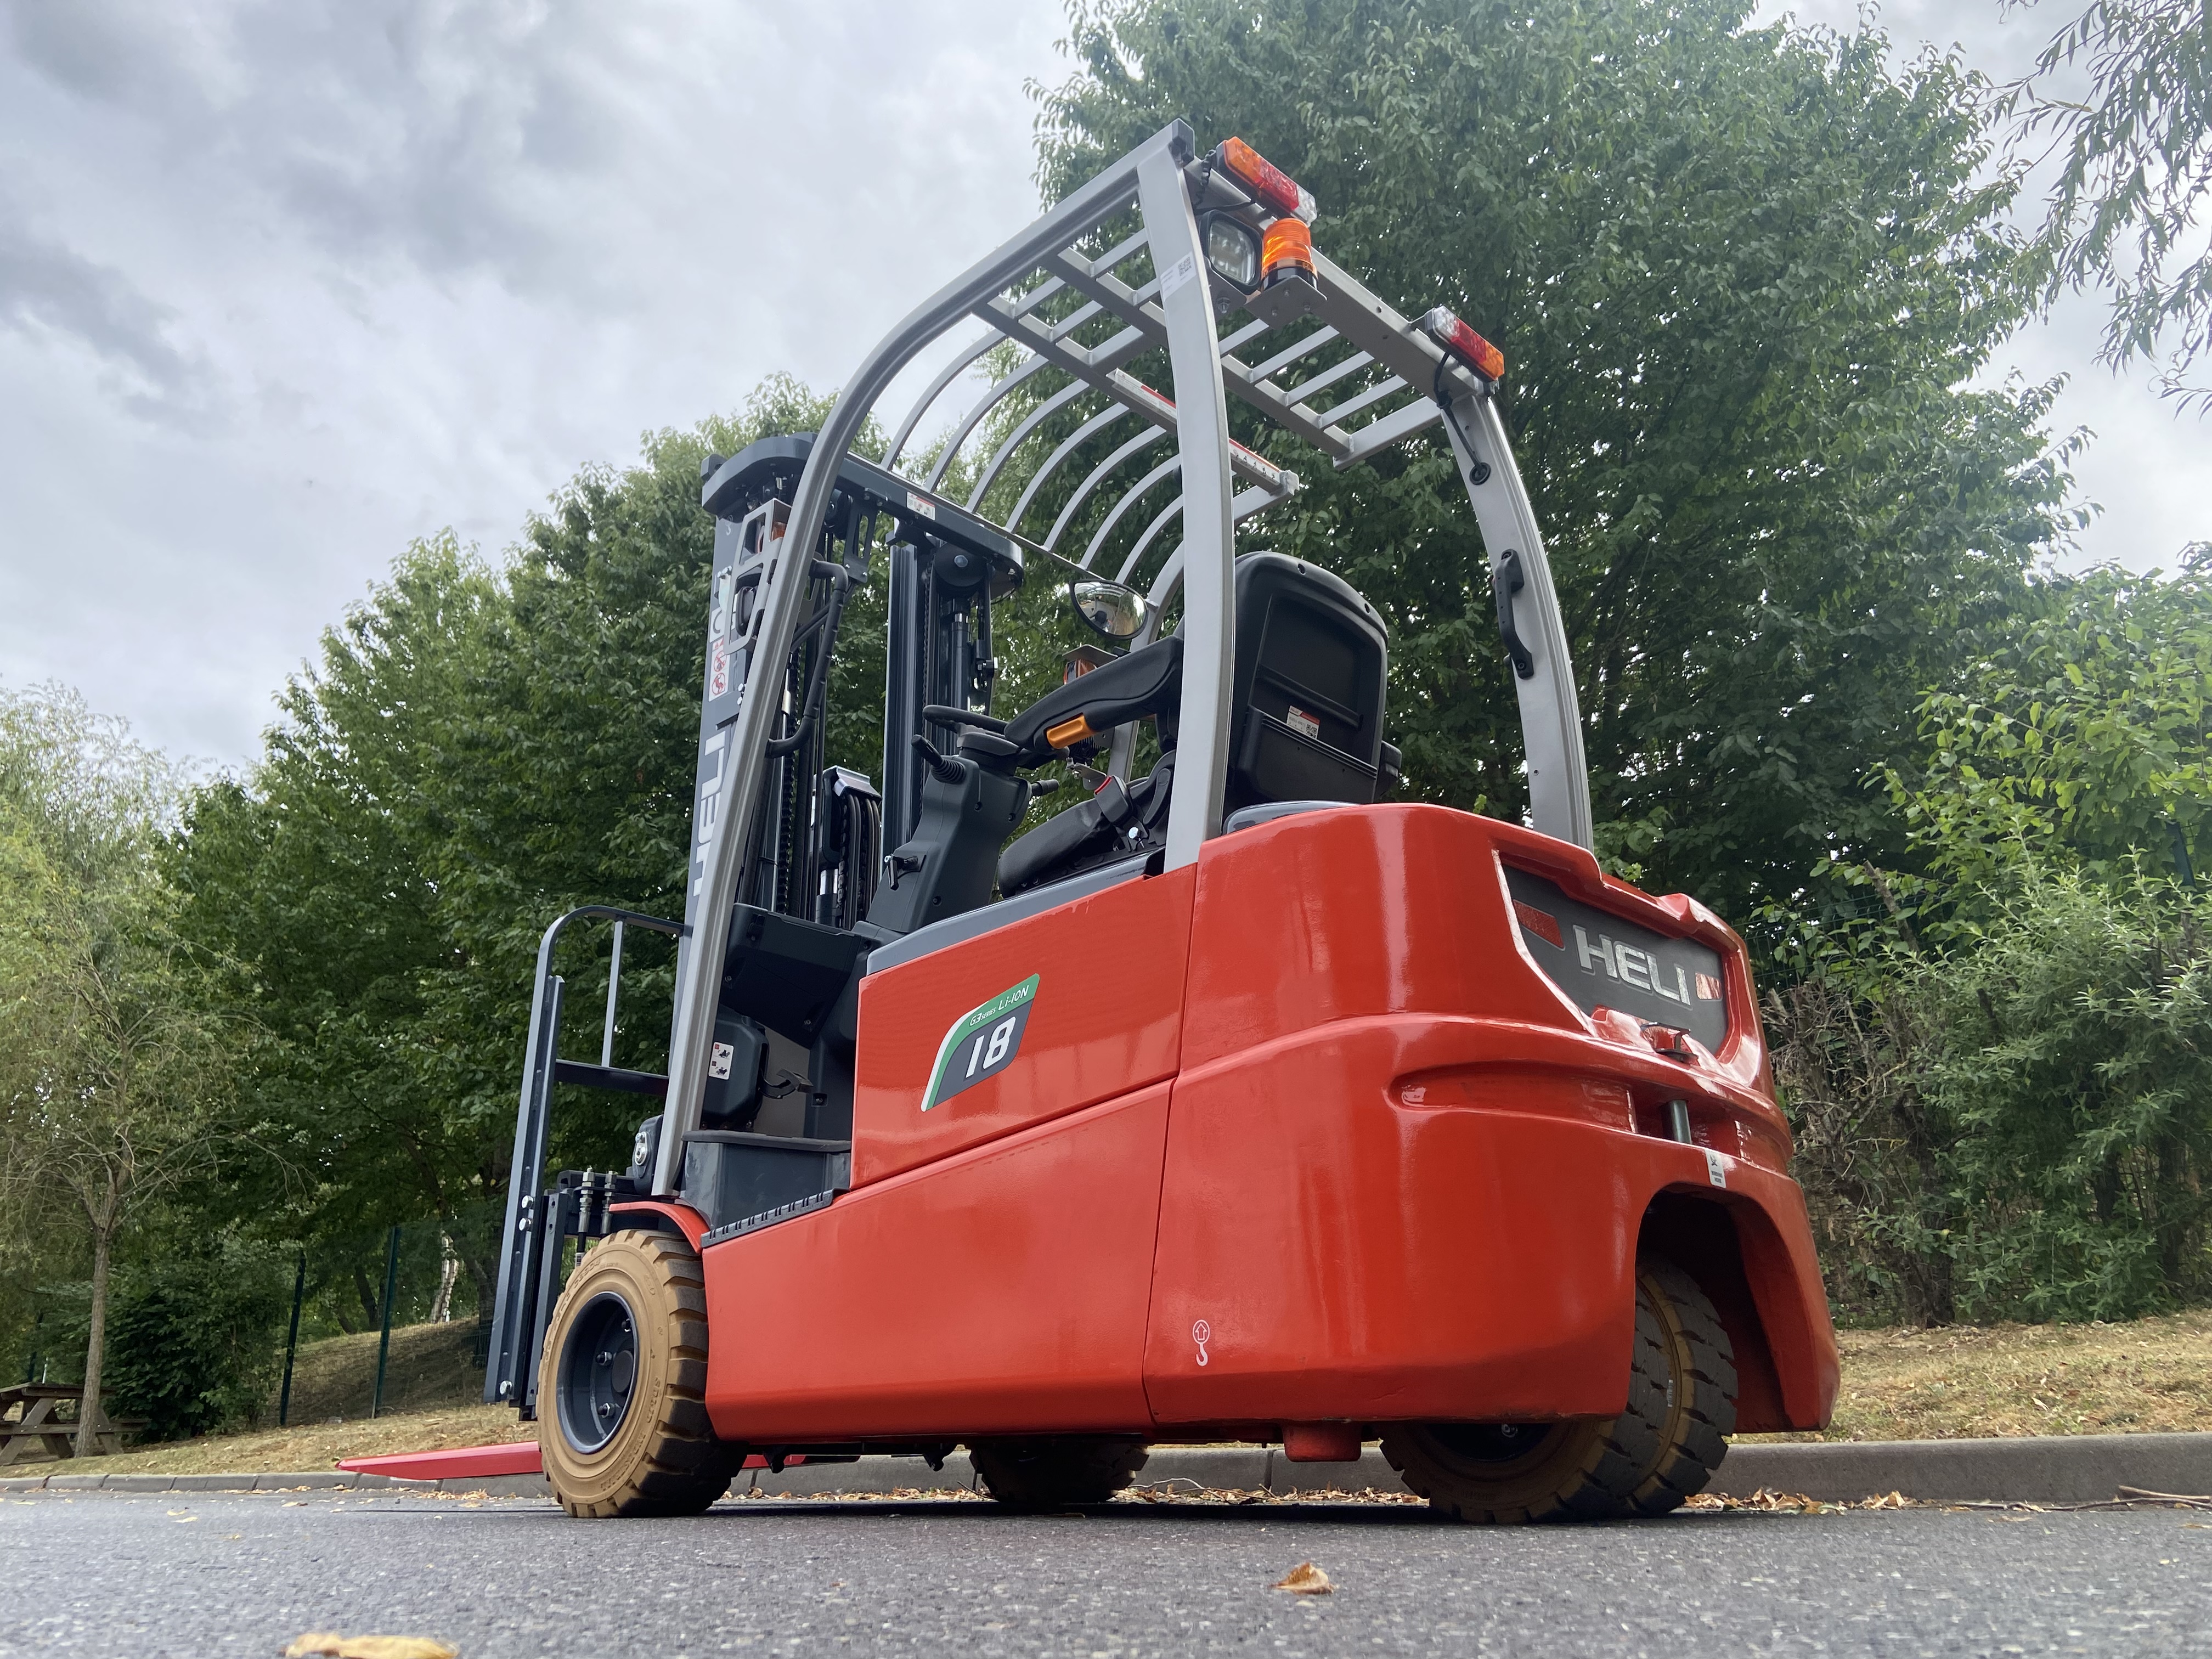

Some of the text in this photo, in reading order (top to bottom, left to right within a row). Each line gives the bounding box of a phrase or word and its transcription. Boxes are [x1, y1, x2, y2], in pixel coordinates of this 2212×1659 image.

[1574, 926, 1691, 1006] HELI
[998, 985, 1030, 1011] Li-ION
[966, 1017, 1015, 1078] 18
